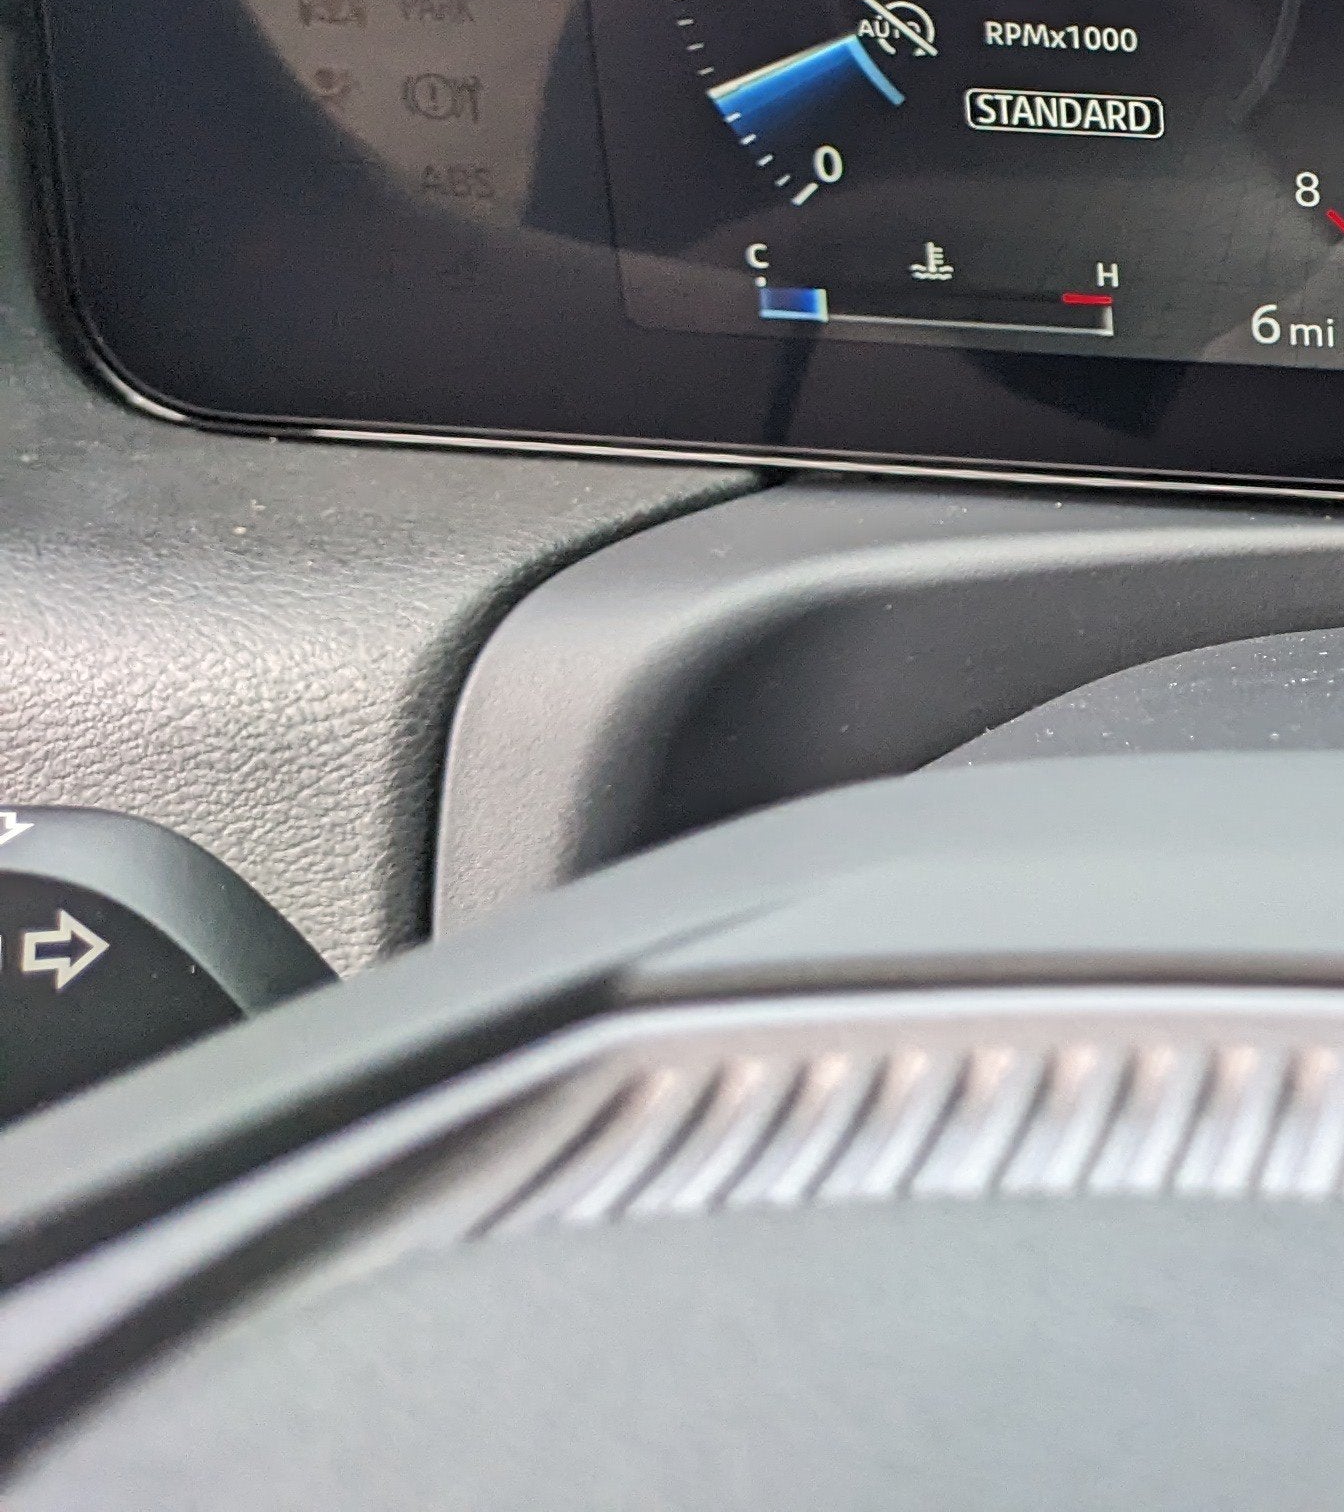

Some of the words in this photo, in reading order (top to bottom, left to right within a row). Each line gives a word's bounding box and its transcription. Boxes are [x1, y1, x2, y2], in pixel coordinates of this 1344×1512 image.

[985, 22, 1139, 54] RPMx1000
[975, 94, 1153, 132] STANDARD
[812, 145, 844, 184] 0
[1293, 173, 1322, 208] 8
[745, 242, 768, 271] C
[1096, 262, 1121, 291] H
[1250, 303, 1282, 346] 6
[1288, 320, 1336, 350] mi
